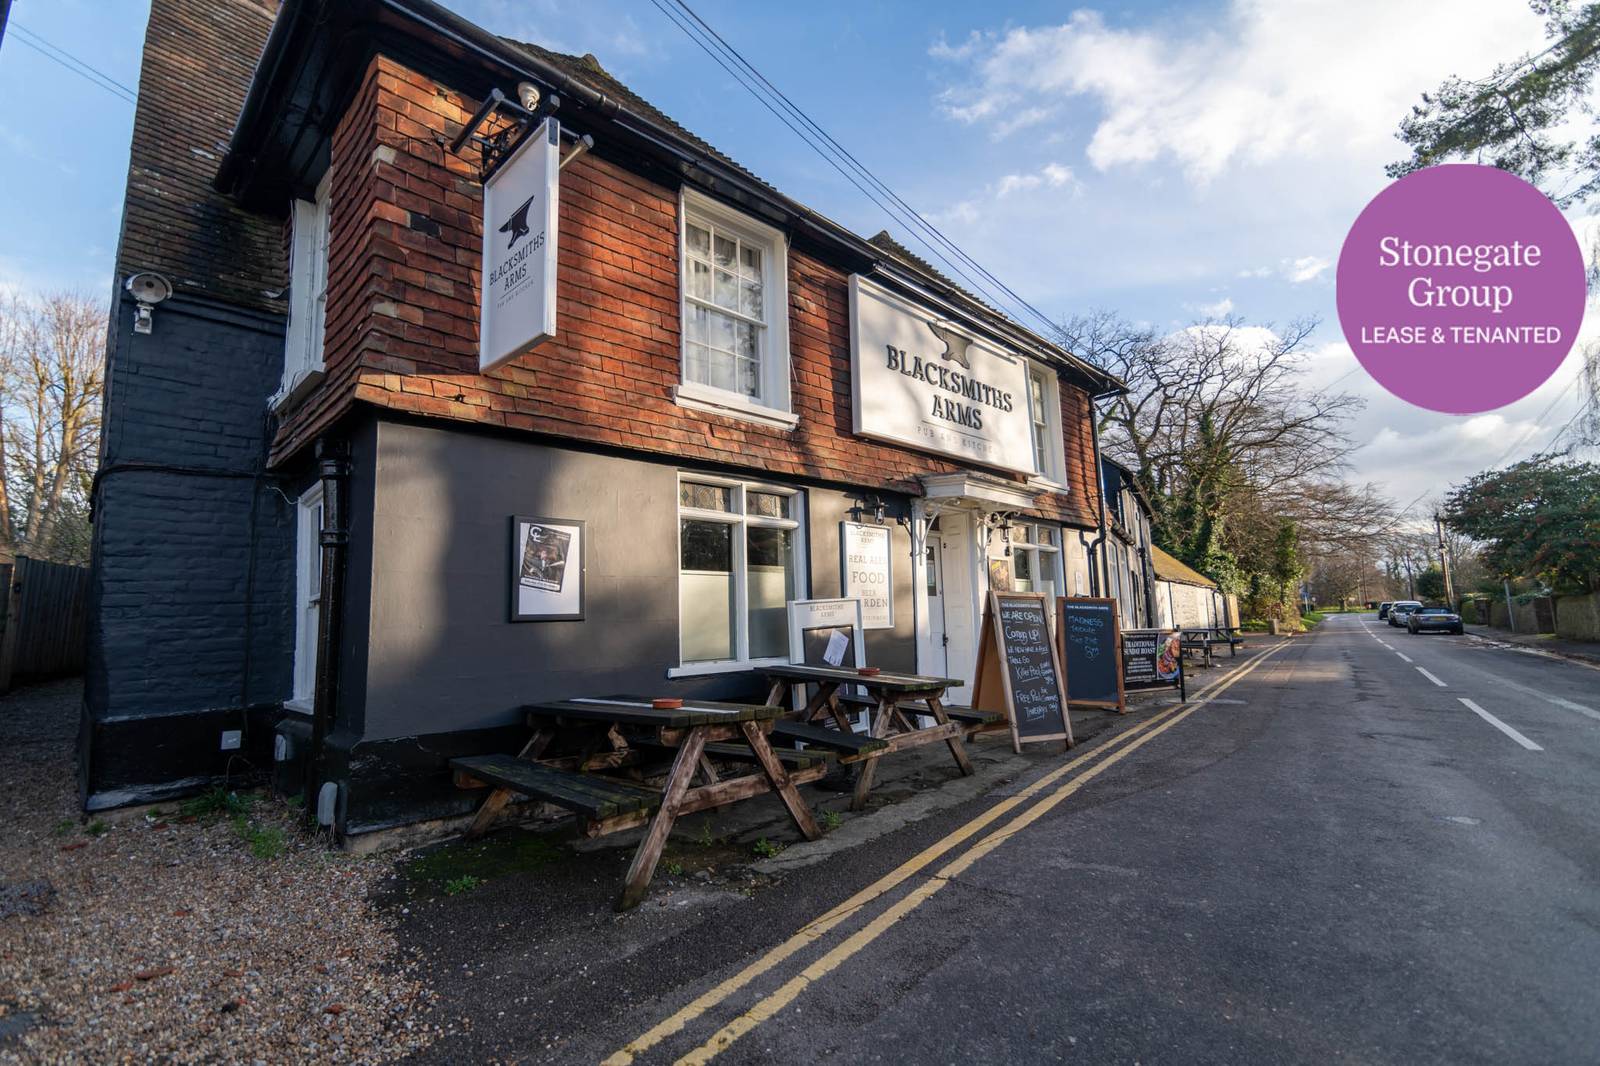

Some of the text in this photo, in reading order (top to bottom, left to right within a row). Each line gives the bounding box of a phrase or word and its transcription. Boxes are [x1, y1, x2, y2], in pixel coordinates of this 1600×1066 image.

[489, 231, 545, 287] BLACKSMITHS
[504, 263, 527, 292] ARMS
[886, 344, 1013, 413] BLACKSMITHS
[931, 394, 983, 430] ARMS
[917, 425, 935, 438] PUB
[848, 554, 867, 565] REAL
[851, 570, 885, 585] FOOD
[863, 598, 888, 609] RDEN
[1124, 640, 1155, 649] TRADITIONAL
[1140, 647, 1156, 655] ROAST
